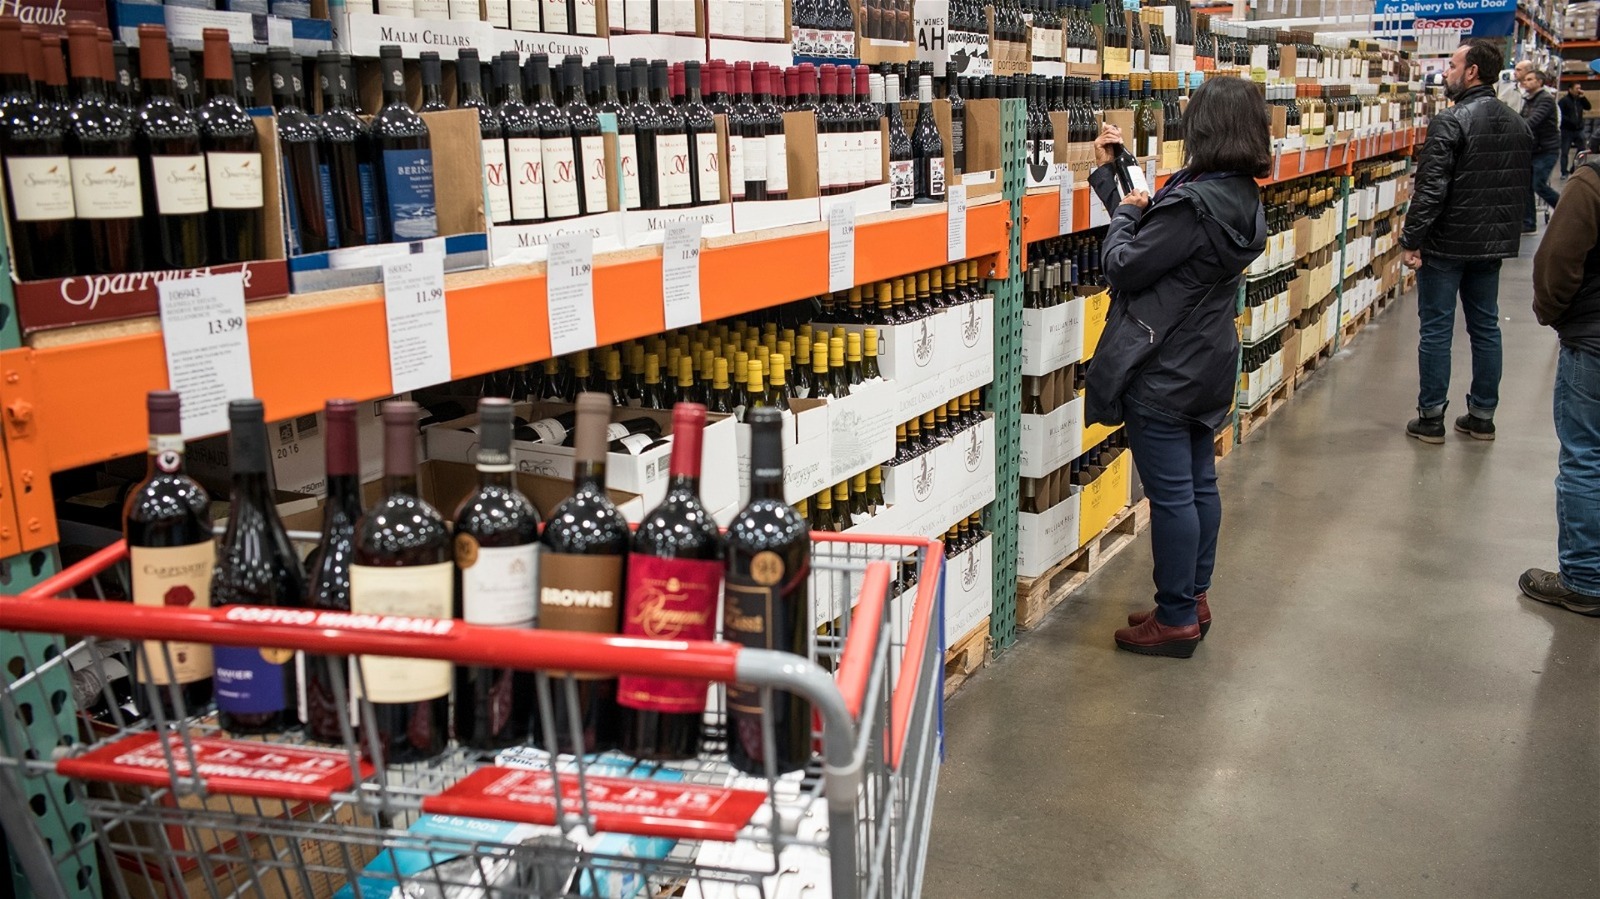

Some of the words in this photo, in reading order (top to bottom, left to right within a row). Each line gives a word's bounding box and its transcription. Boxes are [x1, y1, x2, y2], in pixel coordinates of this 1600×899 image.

[0, 0, 66, 26] Hawk
[1384, 4, 1399, 13] for
[1401, 2, 1441, 13] Delivery
[1444, 2, 1454, 10] to
[1457, 0, 1478, 9] Your
[1481, 0, 1508, 8] Door
[924, 18, 945, 26] WINES
[1414, 18, 1474, 30] COSTCO
[380, 27, 418, 43] MALM
[423, 30, 470, 47] CELLARS
[514, 39, 545, 53] MALM
[548, 41, 589, 56] CELLARS
[997, 59, 1028, 72] portlandia
[682, 248, 699, 259] 11.99
[571, 264, 591, 276] 11.99
[417, 288, 442, 303] 11.99
[208, 316, 243, 334] 13.99
[277, 443, 299, 459] 2016
[783, 461, 820, 488] Bourgogne
[541, 586, 613, 607] BROWNE
[226, 606, 316, 625] COSTCO
[316, 612, 454, 635] WHOLESALE
[197, 763, 323, 785] WHOLESALE
[432, 814, 449, 824] up
[450, 817, 465, 827] to
[467, 820, 499, 834] 100%
